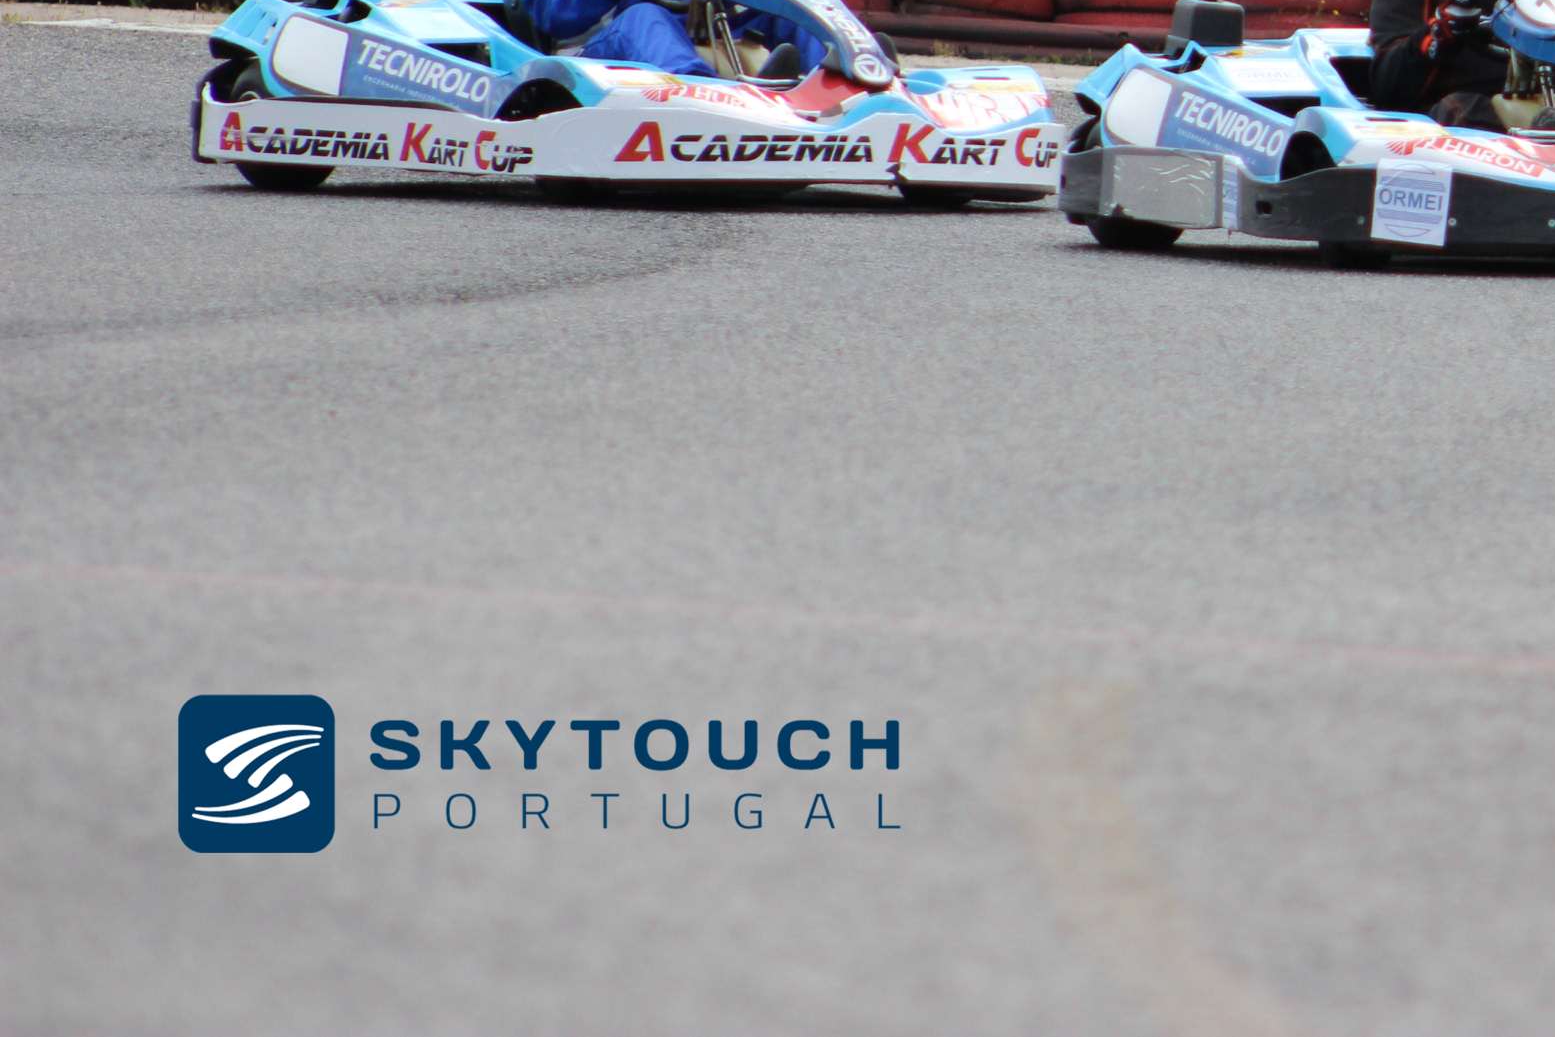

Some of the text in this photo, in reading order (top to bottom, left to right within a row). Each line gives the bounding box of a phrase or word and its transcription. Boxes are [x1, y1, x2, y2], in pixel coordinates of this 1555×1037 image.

[357, 39, 490, 102] TECNIROLO
[219, 112, 533, 173] ACADEMIA KART CUP
[614, 121, 1059, 168] ACADEMIA KART CUP
[1174, 91, 1285, 157] TECNIROLO
[1446, 138, 1536, 175] HURON
[1378, 187, 1443, 212] ORMEI
